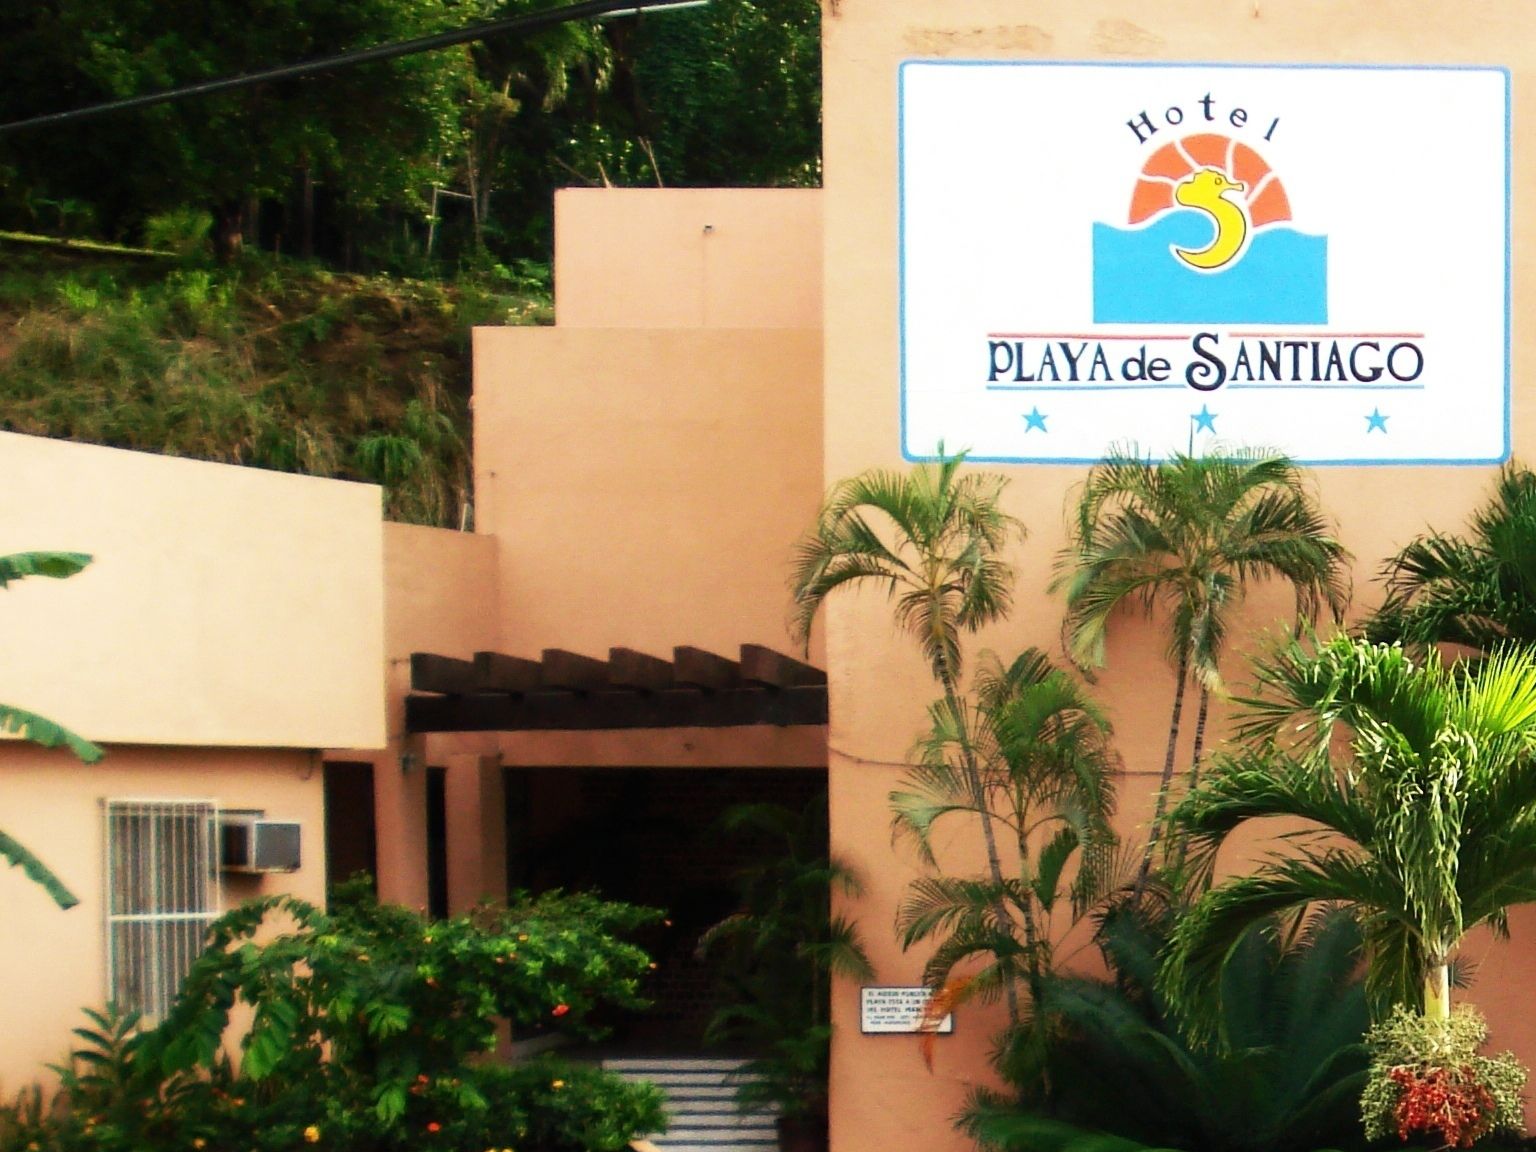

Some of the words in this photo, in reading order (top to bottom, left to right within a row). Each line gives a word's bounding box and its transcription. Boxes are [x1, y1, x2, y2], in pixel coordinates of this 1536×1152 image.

[1126, 92, 1280, 144] Hotel
[987, 340, 1114, 382] PLAYA
[1121, 345, 1172, 381] de
[1185, 332, 1425, 391] SANTIAGO
